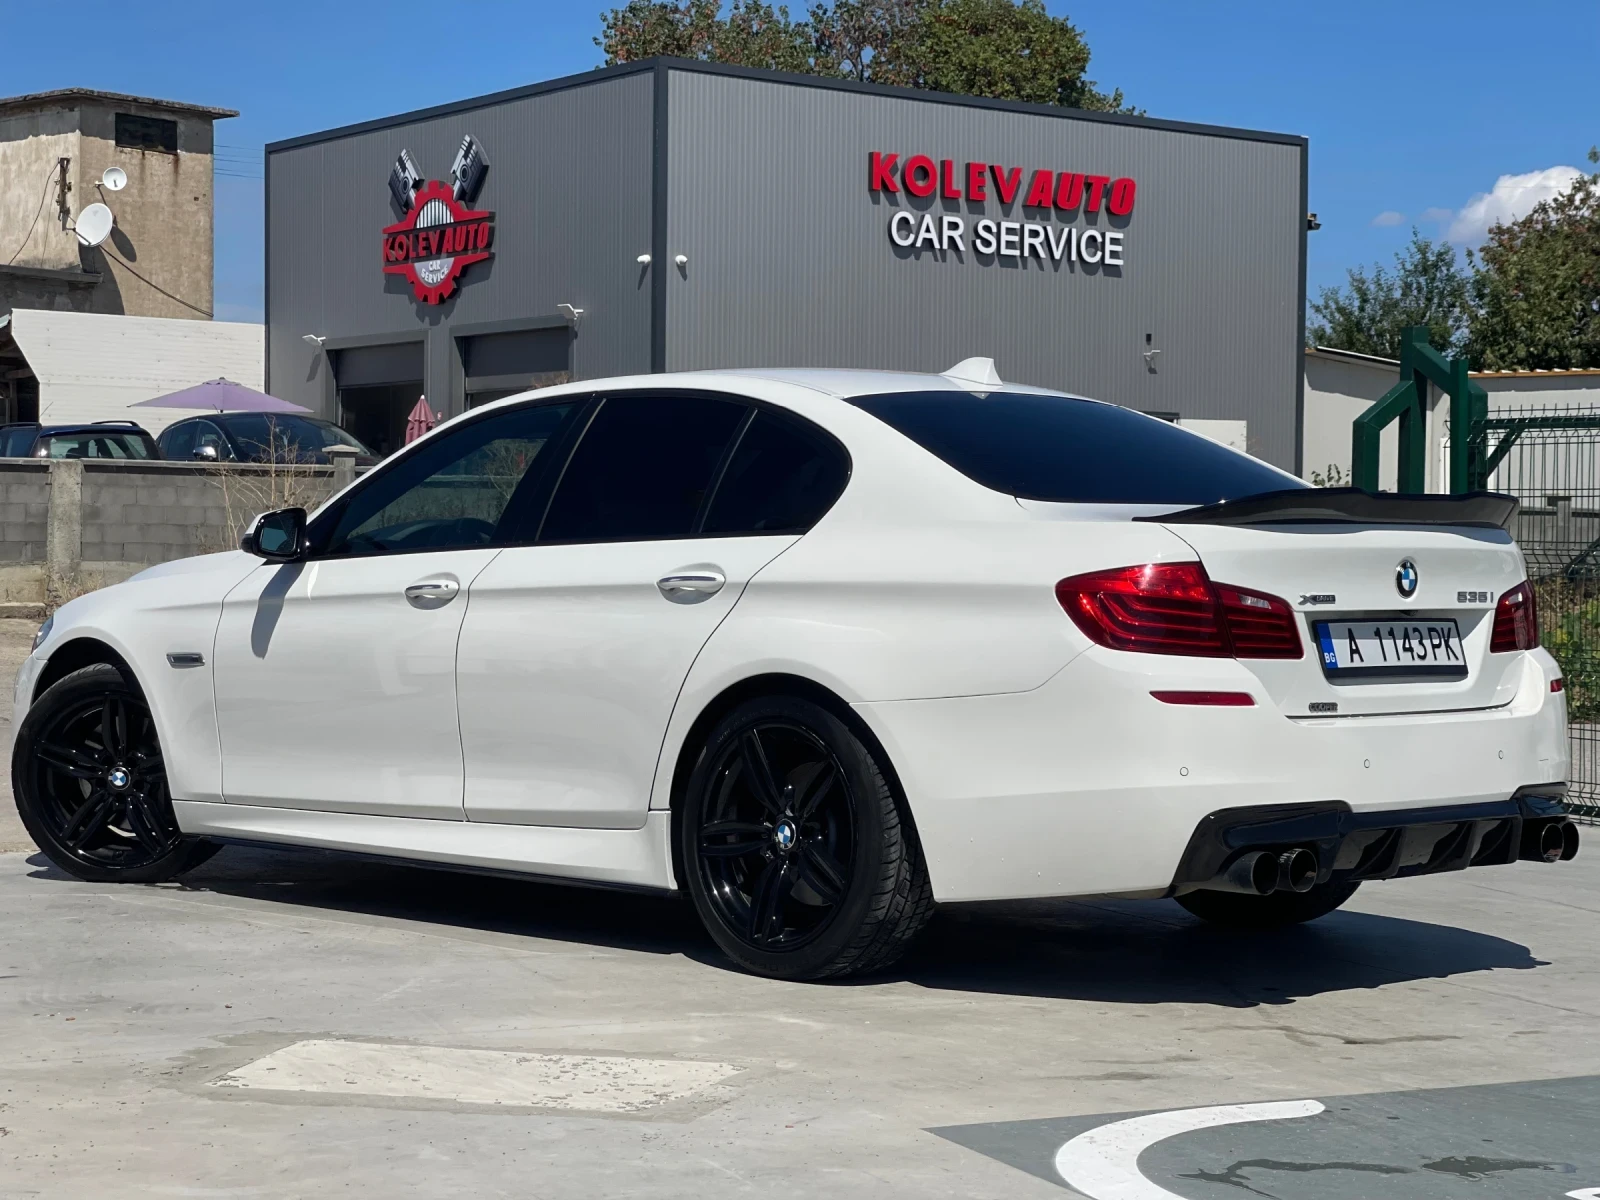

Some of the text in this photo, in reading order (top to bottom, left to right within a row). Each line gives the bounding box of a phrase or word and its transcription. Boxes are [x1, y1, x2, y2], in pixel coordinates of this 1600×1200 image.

[870, 152, 1137, 216] KOLEV AUTO
[890, 211, 1124, 266] CAR SERVICE
[421, 264, 448, 283] SERVICE
[428, 260, 441, 271] CAR
[1324, 652, 1336, 664] BG
[1347, 627, 1364, 664] A
